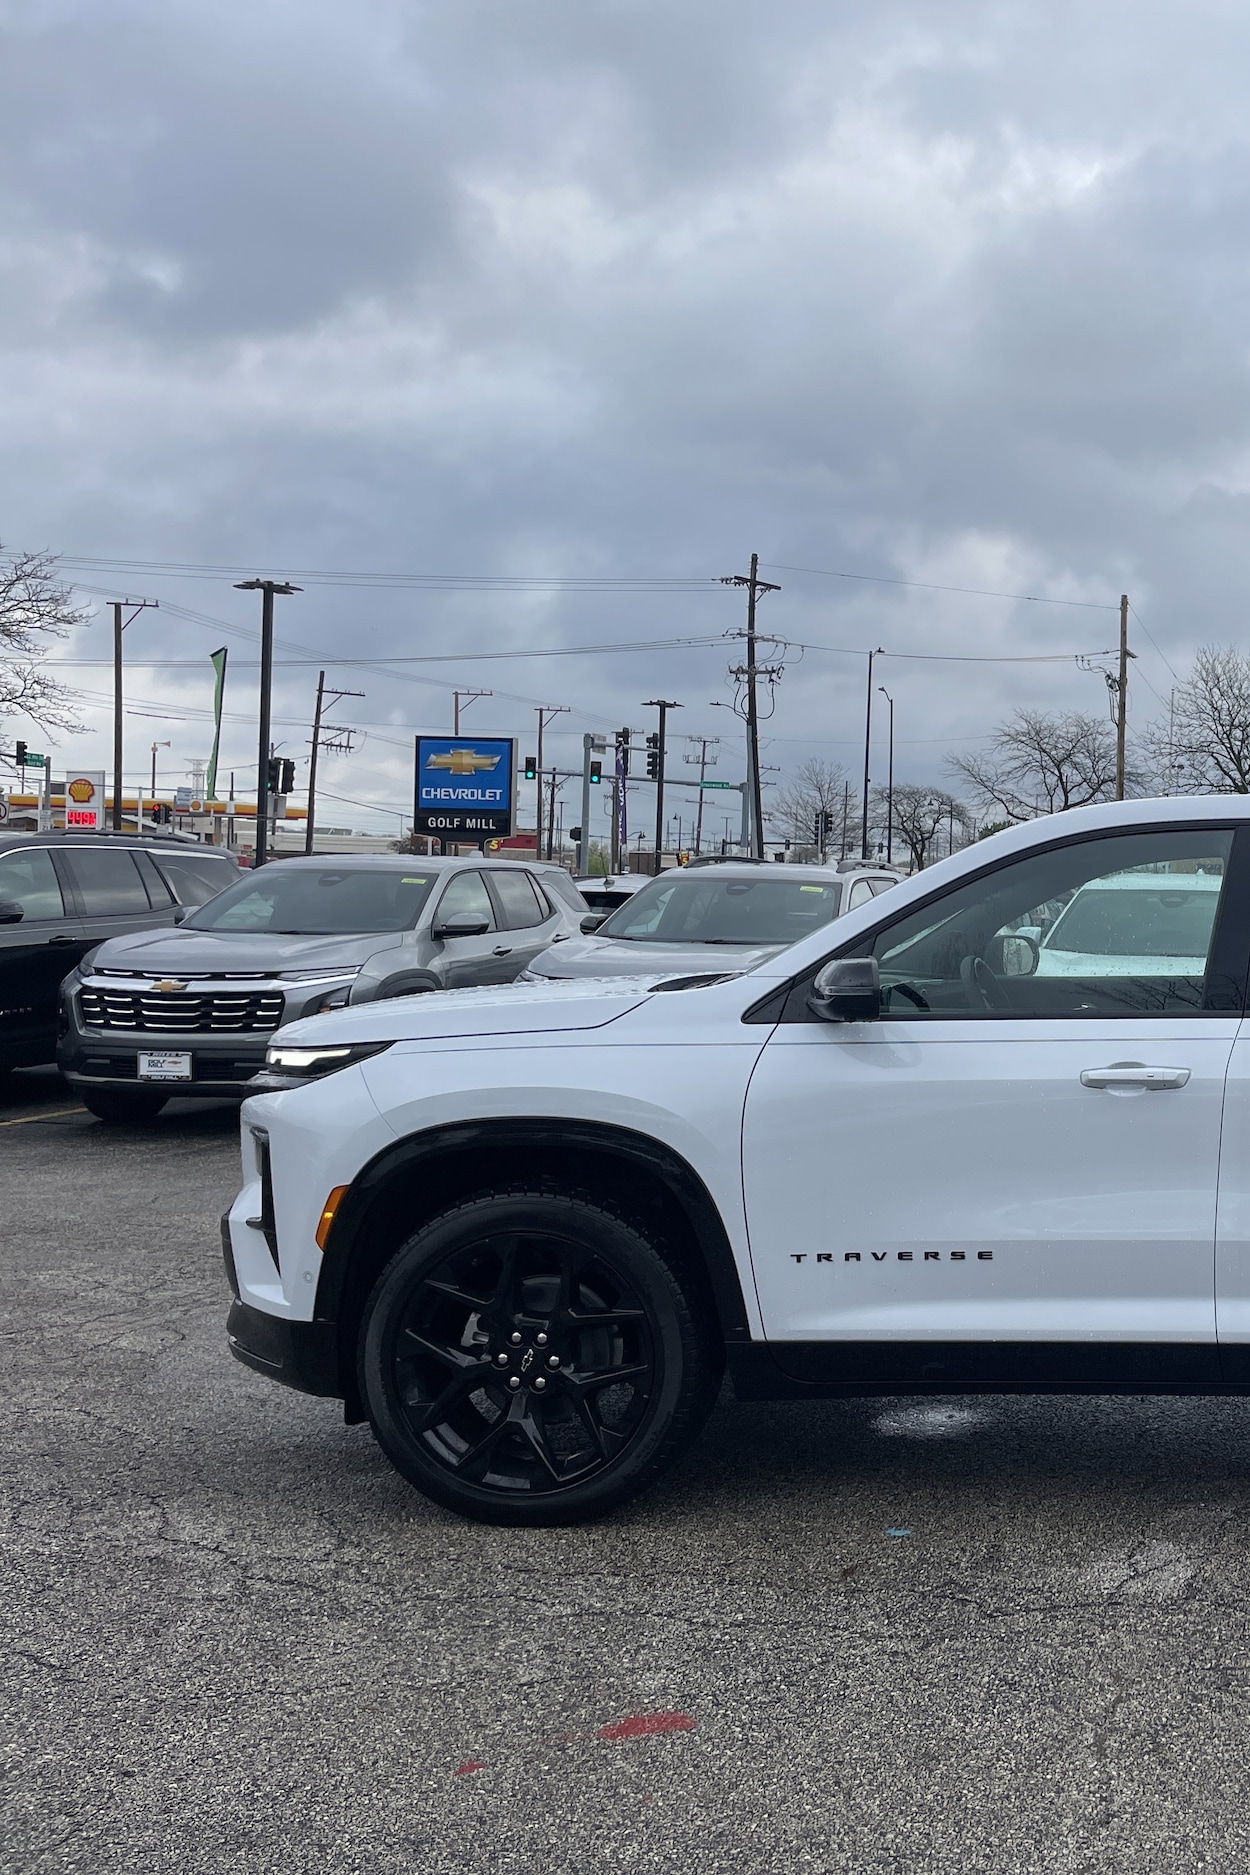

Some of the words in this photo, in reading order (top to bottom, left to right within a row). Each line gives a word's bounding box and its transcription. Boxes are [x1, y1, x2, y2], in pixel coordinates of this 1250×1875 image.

[422, 788, 502, 800] CHEVROLET
[428, 817, 460, 829] GOLF
[466, 818, 496, 829] MILL
[790, 1251, 994, 1264] TRAVERSE
